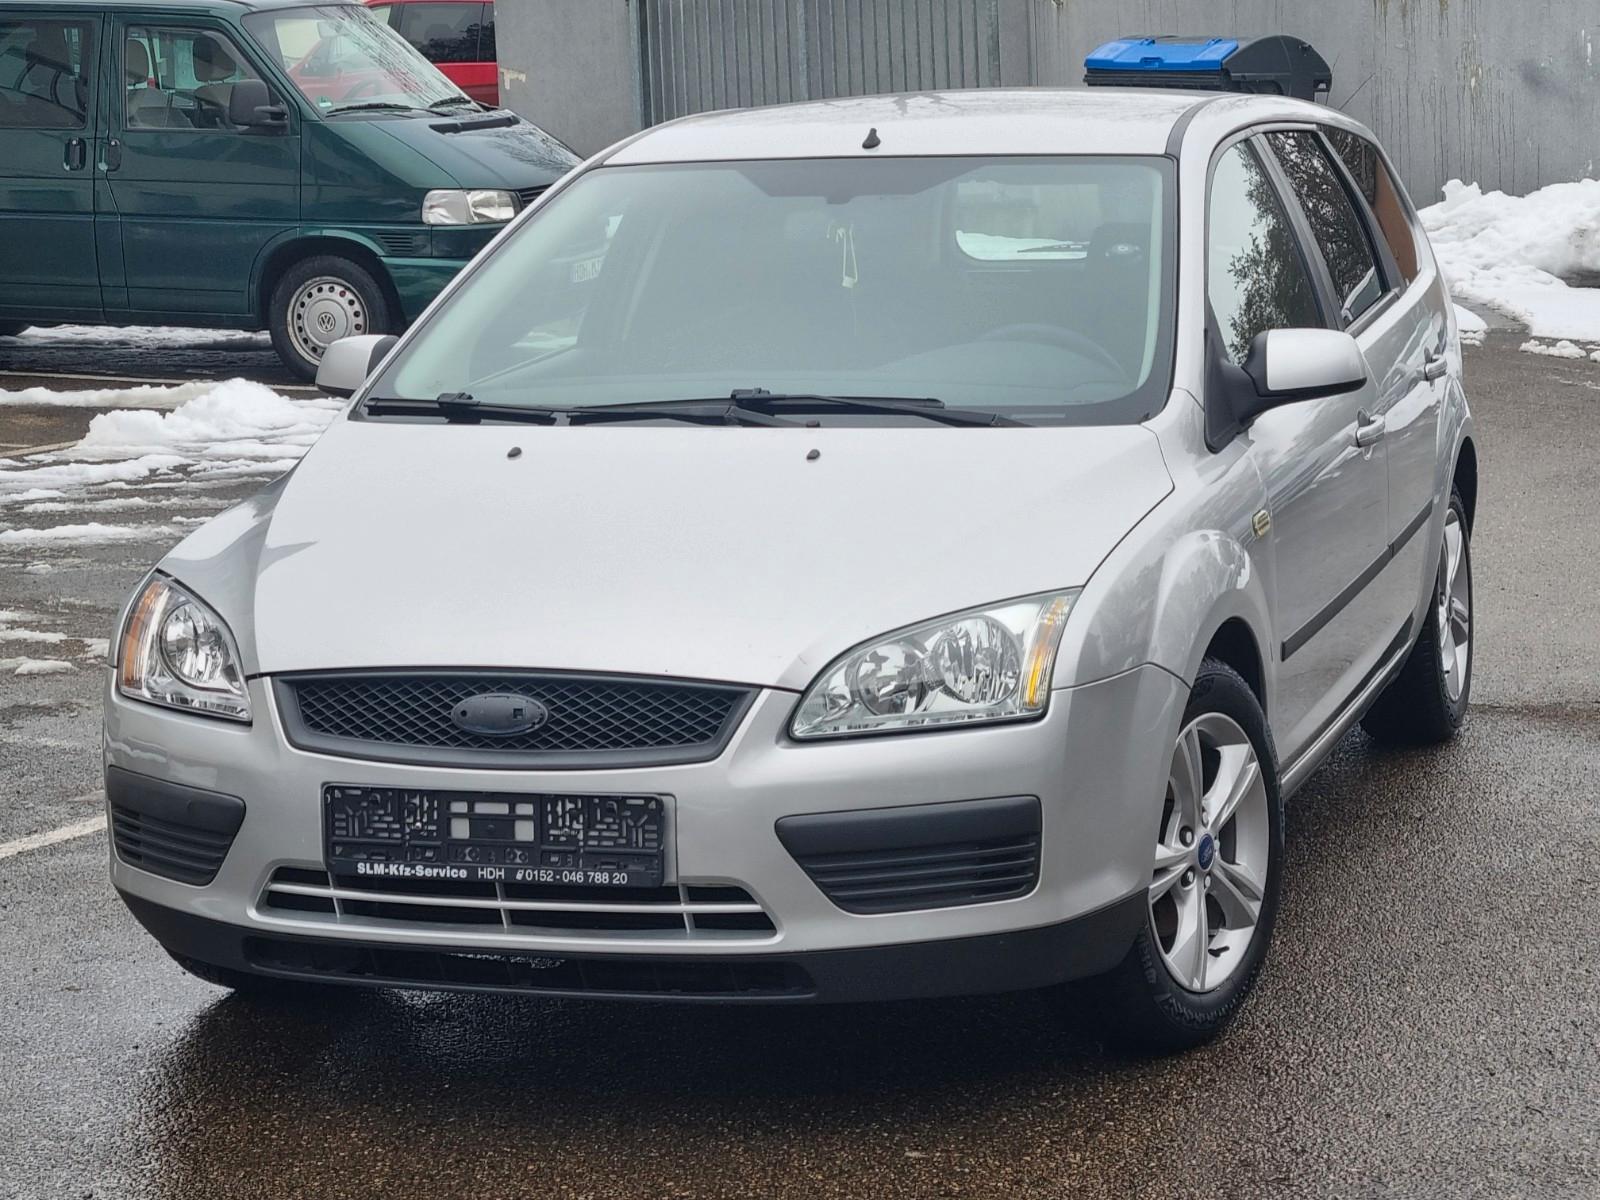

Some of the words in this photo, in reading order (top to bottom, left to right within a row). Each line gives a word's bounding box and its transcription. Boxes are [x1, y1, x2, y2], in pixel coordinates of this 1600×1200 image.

[356, 862, 467, 878] SLM-Kfz-Service
[478, 867, 504, 879] HDH
[525, 869, 554, 882] 0152
[562, 870, 584, 883] 046
[587, 871, 609, 884] 788
[612, 872, 627, 884] 20
